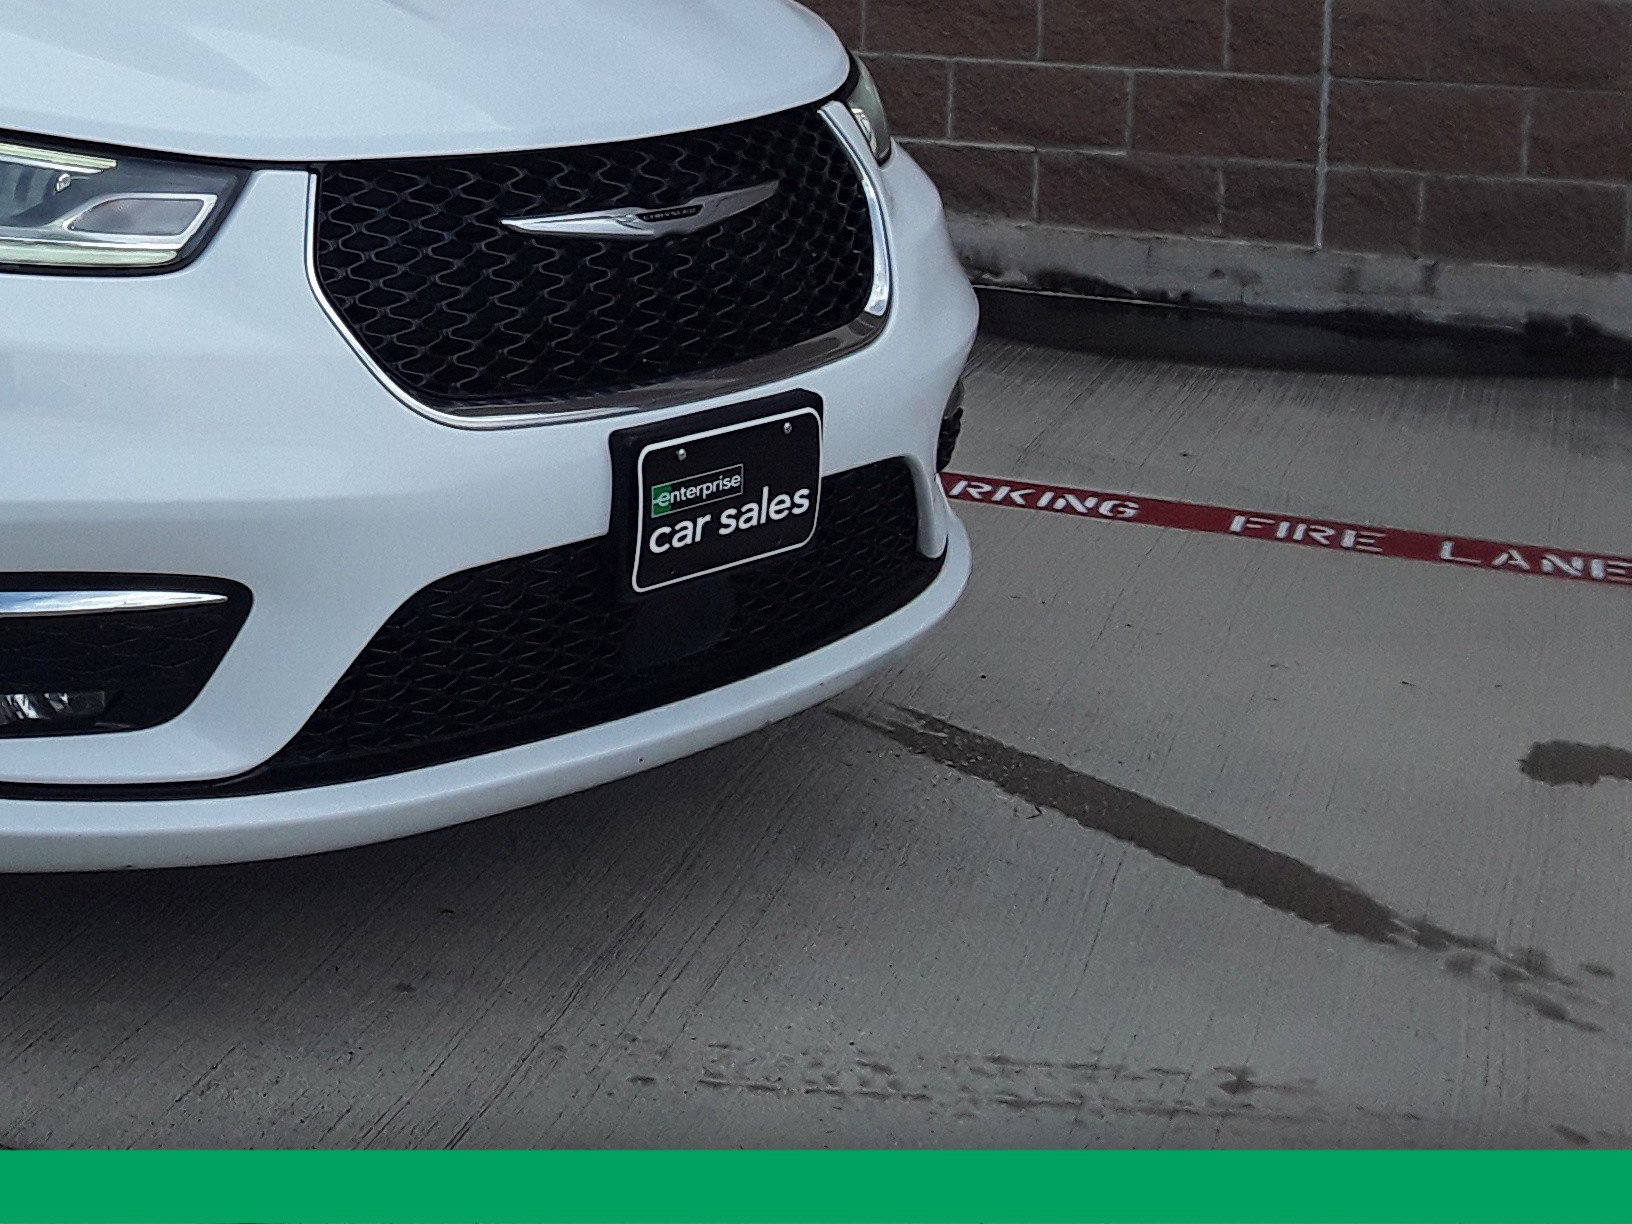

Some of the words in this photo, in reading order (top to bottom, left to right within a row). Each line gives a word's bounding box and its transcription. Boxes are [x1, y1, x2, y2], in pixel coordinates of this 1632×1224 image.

[649, 514, 712, 554] car
[718, 486, 811, 535] sales
[654, 475, 741, 507] enterprise
[948, 480, 1140, 518] RKING
[1228, 514, 1386, 553] FIRE
[1440, 541, 1632, 581] LANE
